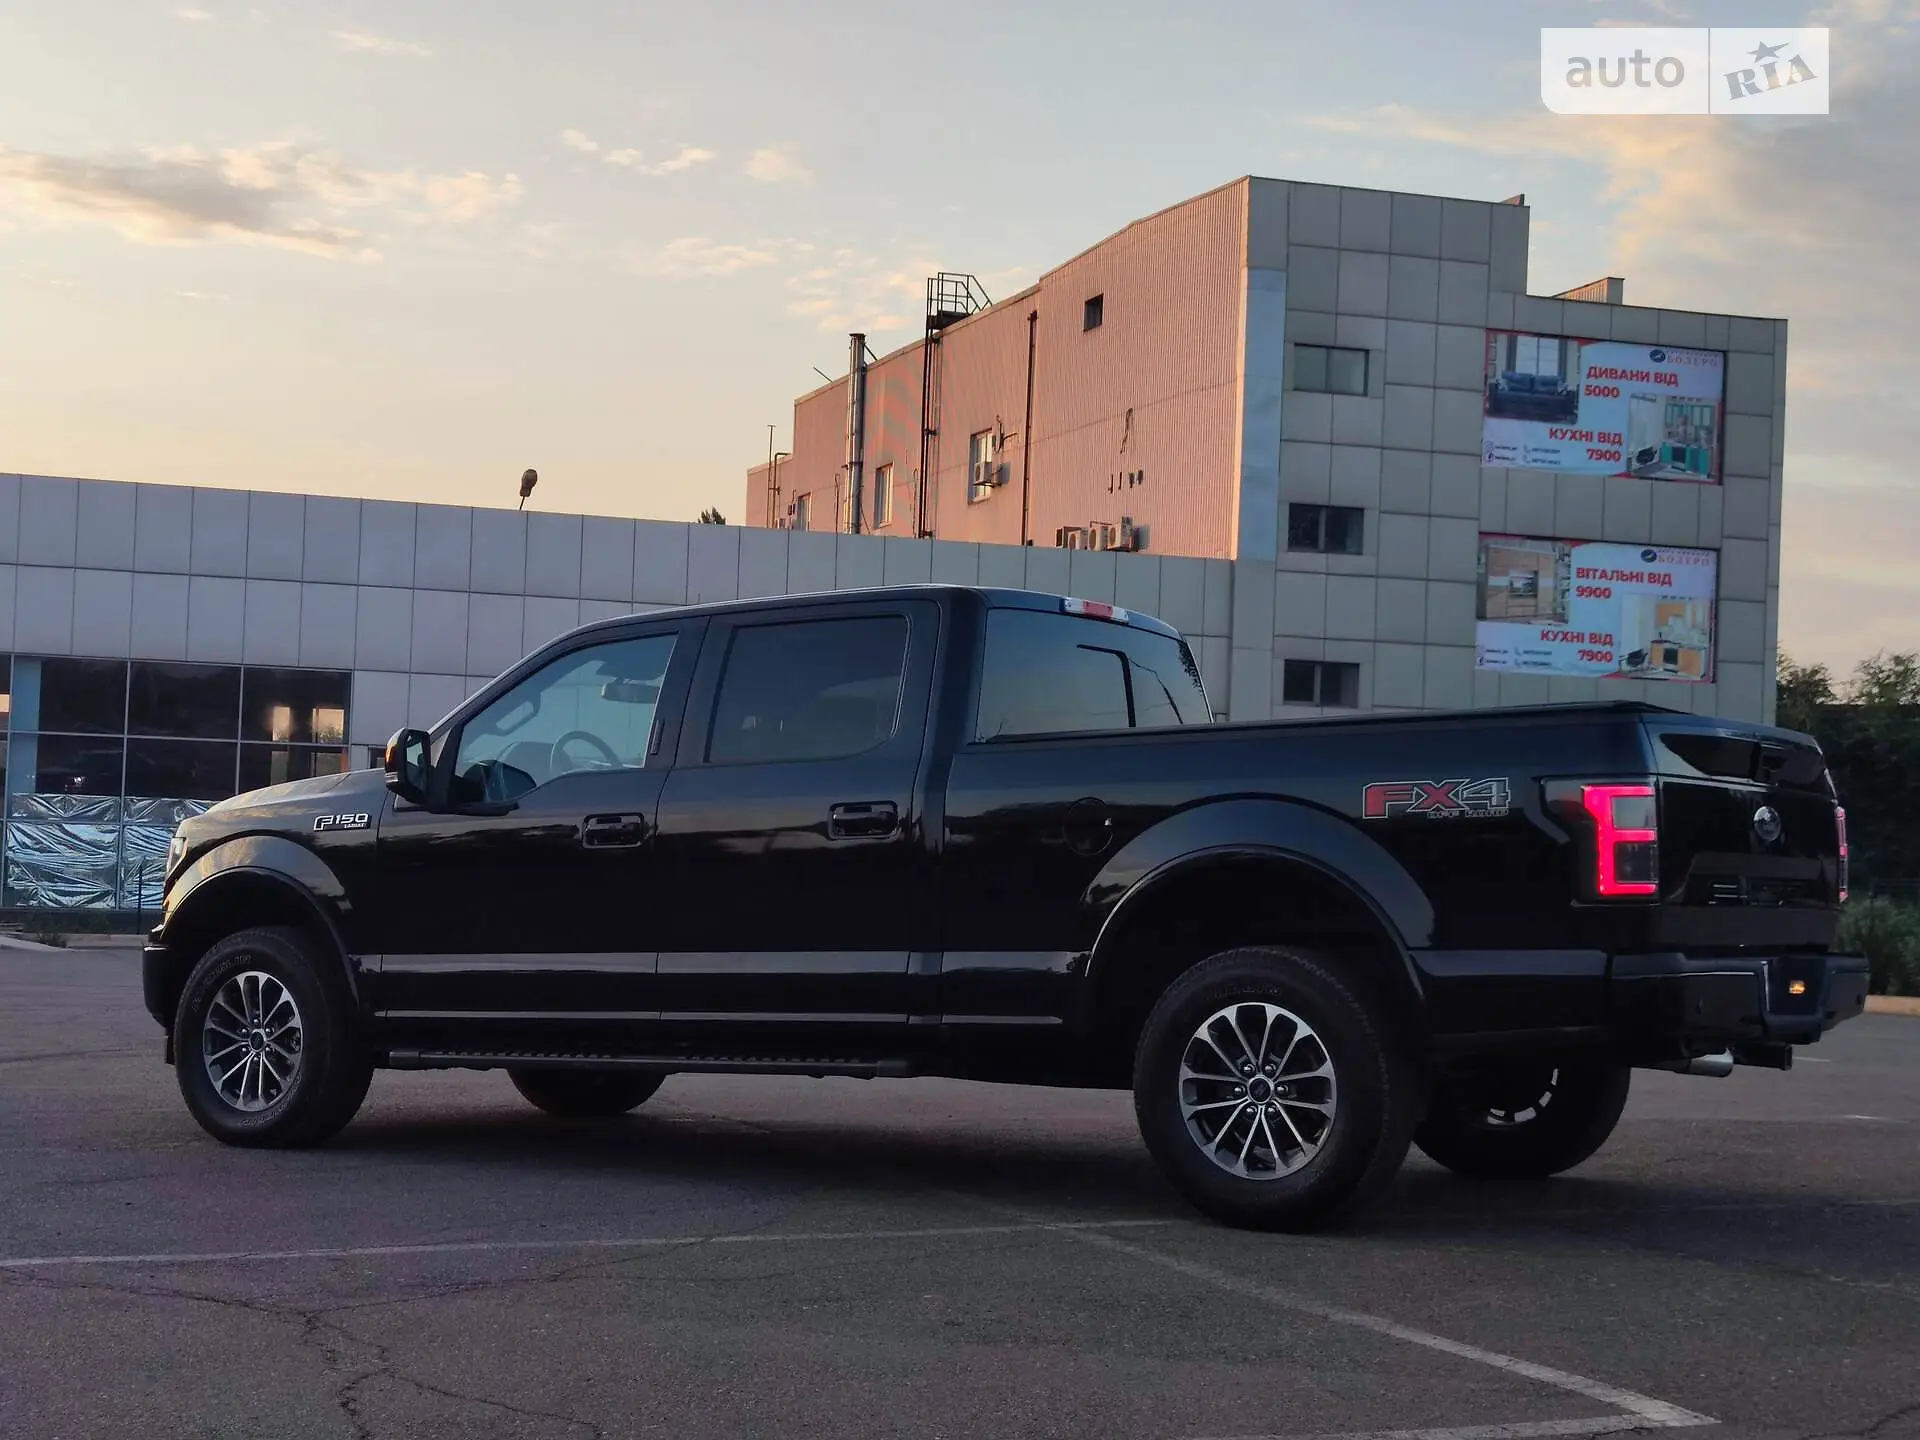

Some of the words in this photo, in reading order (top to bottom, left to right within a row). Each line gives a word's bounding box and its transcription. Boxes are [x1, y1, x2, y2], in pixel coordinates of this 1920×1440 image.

[1586, 366, 1650, 382] ДИВАНИ
[1654, 372, 1679, 387] ВІД
[1584, 384, 1621, 398] 5000
[1549, 427, 1593, 443] КУХНІ
[1597, 431, 1623, 447] ВІД
[1586, 448, 1622, 462] 7900
[1576, 567, 1644, 583] ВІТАЛЬНІ
[1647, 572, 1673, 587] ВІД
[1576, 585, 1612, 599] 9900
[1540, 629, 1584, 643] КУХНІ
[1589, 632, 1613, 647] ВІД
[1577, 649, 1613, 662] 7900
[1363, 777, 1511, 819] FX4
